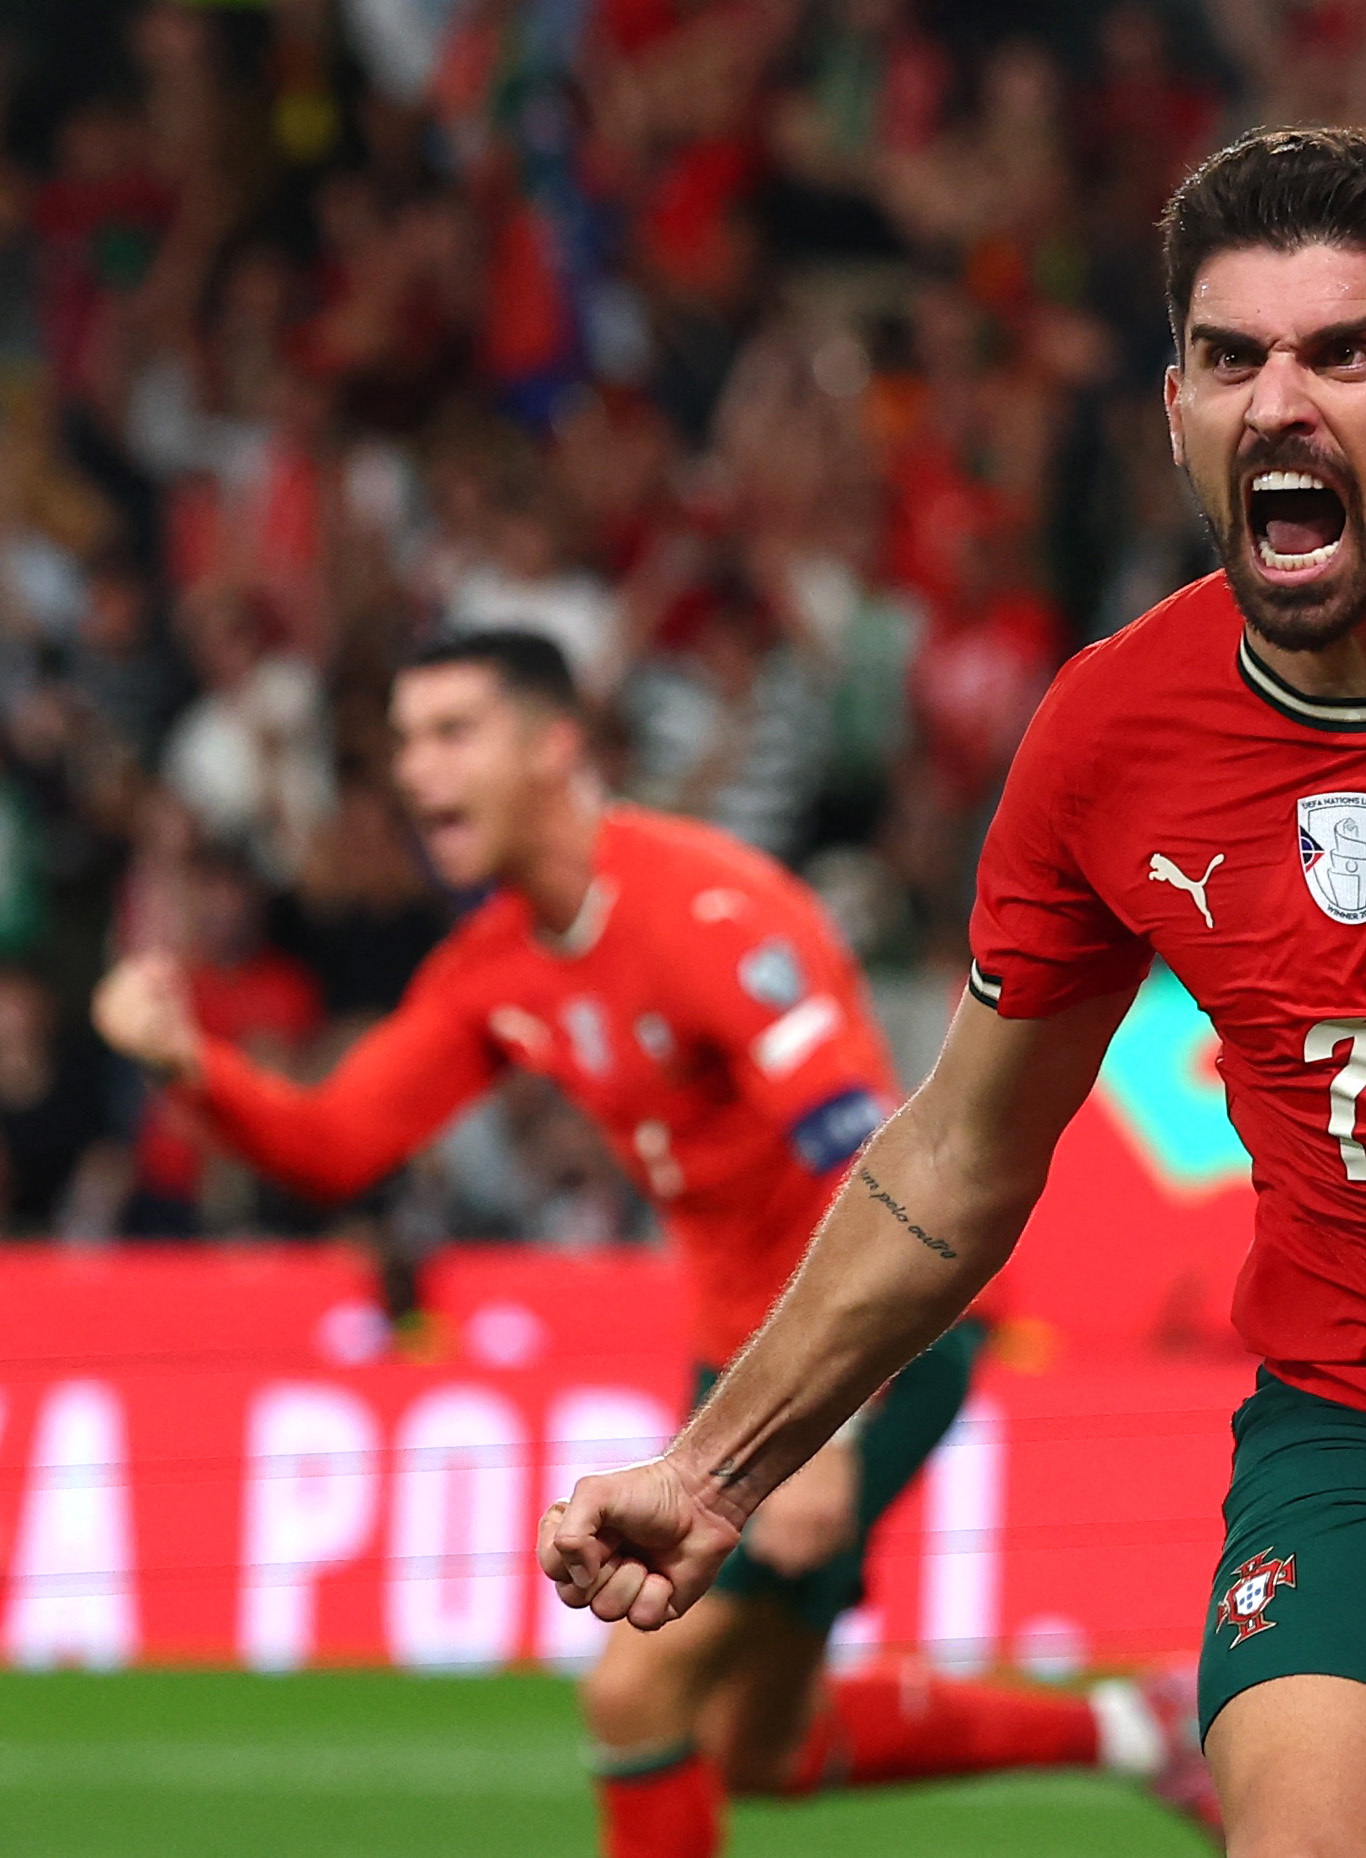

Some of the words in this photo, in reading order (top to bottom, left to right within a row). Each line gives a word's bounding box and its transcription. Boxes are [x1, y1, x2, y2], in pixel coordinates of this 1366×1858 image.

[1302, 799, 1322, 810] UEFA
[1324, 797, 1360, 805] NATIONS
[1327, 903, 1360, 920] WINNER
